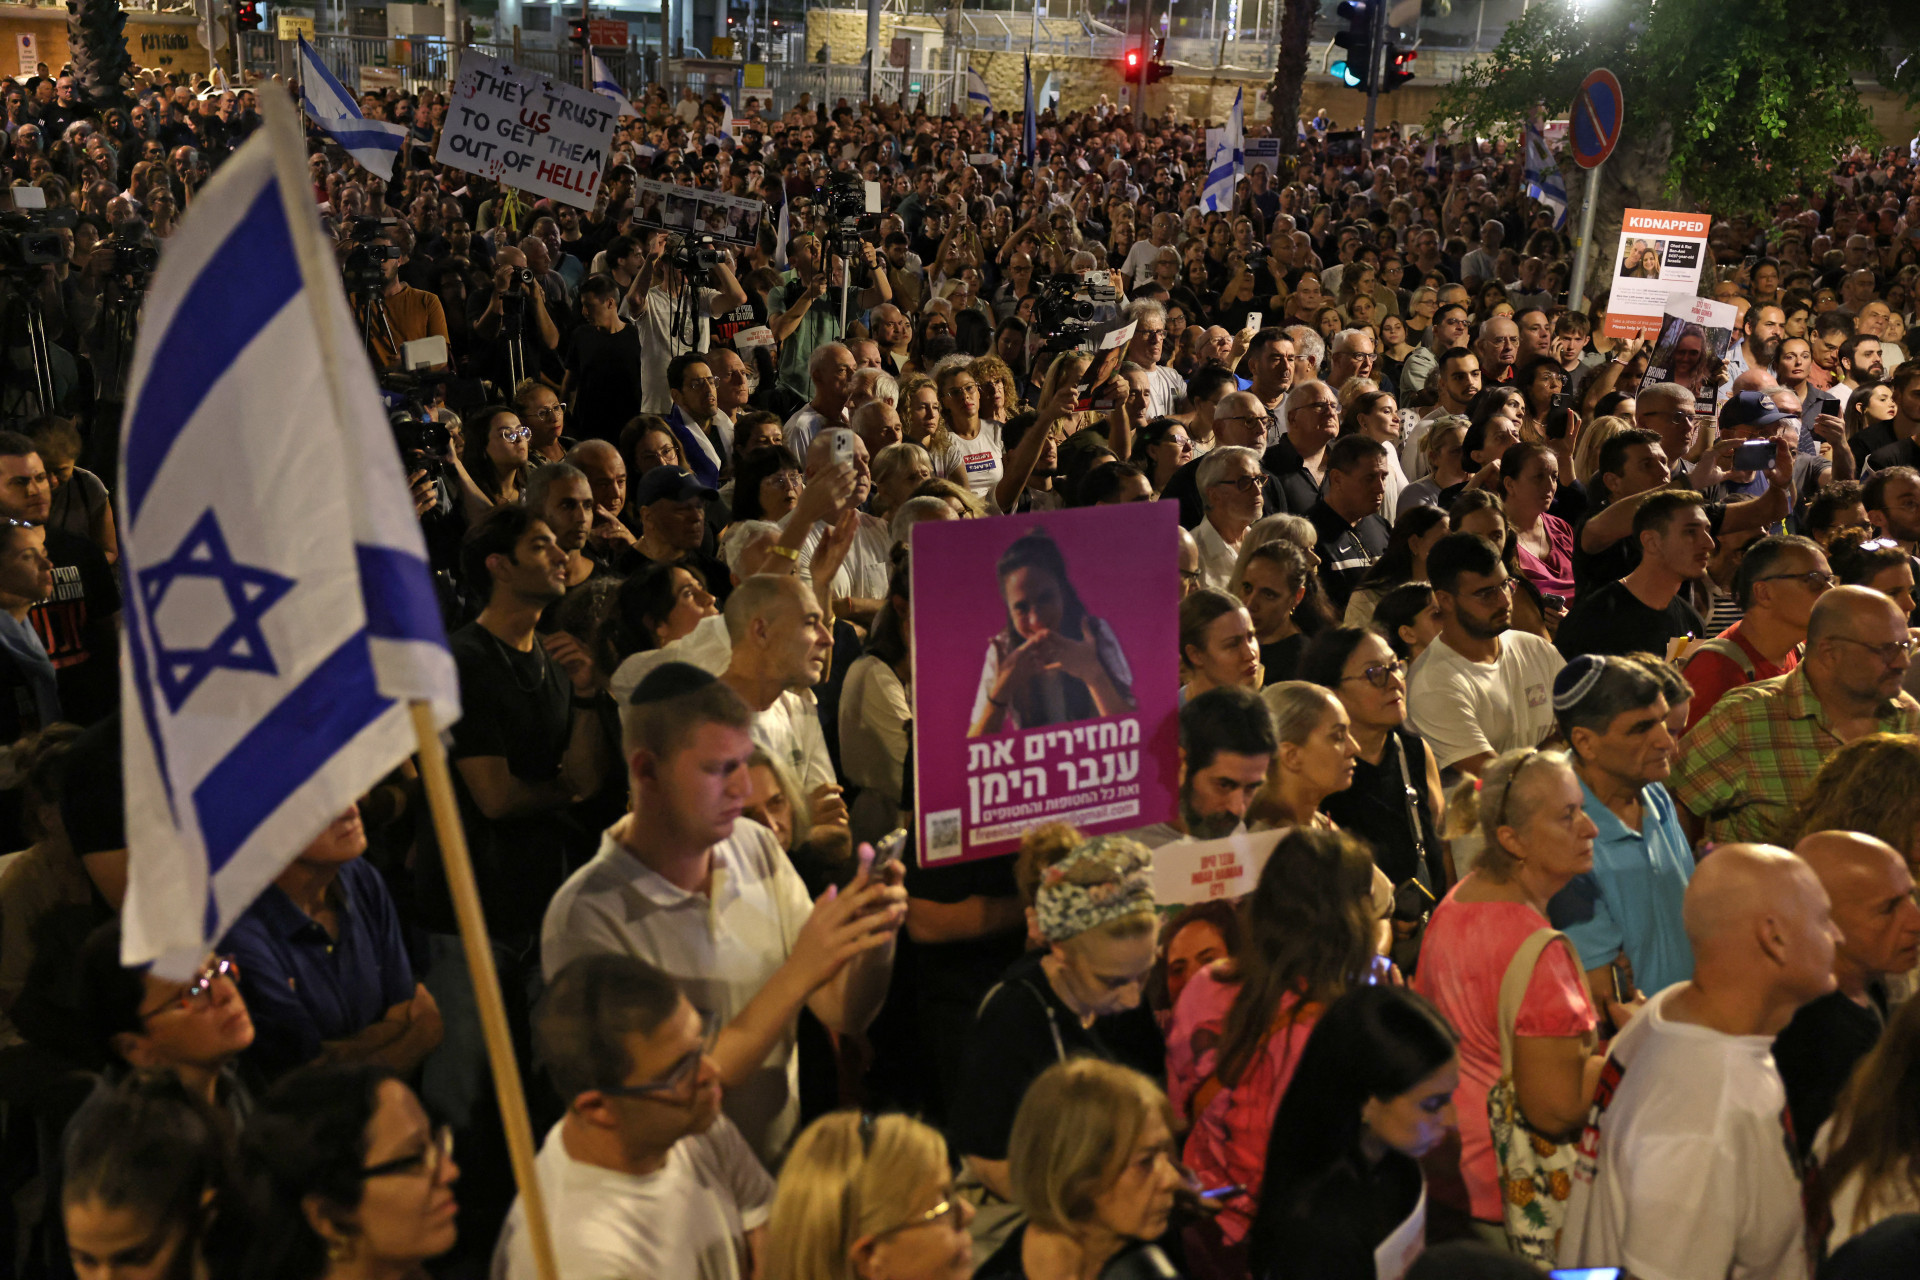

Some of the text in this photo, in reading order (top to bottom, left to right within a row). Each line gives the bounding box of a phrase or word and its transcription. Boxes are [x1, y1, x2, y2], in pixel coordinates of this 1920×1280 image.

[475, 70, 613, 133] THEY TRUST
[520, 108, 552, 133] US
[450, 134, 599, 197] OUT OF HELL!
[460, 107, 601, 172] TO GET THEM
[1629, 216, 1704, 232] KIDNAPPED
[967, 718, 1140, 771] מחזירים את
[967, 749, 1140, 825] ענבר הימן
[982, 783, 1140, 823] ואת כל החטופות והחטופים
